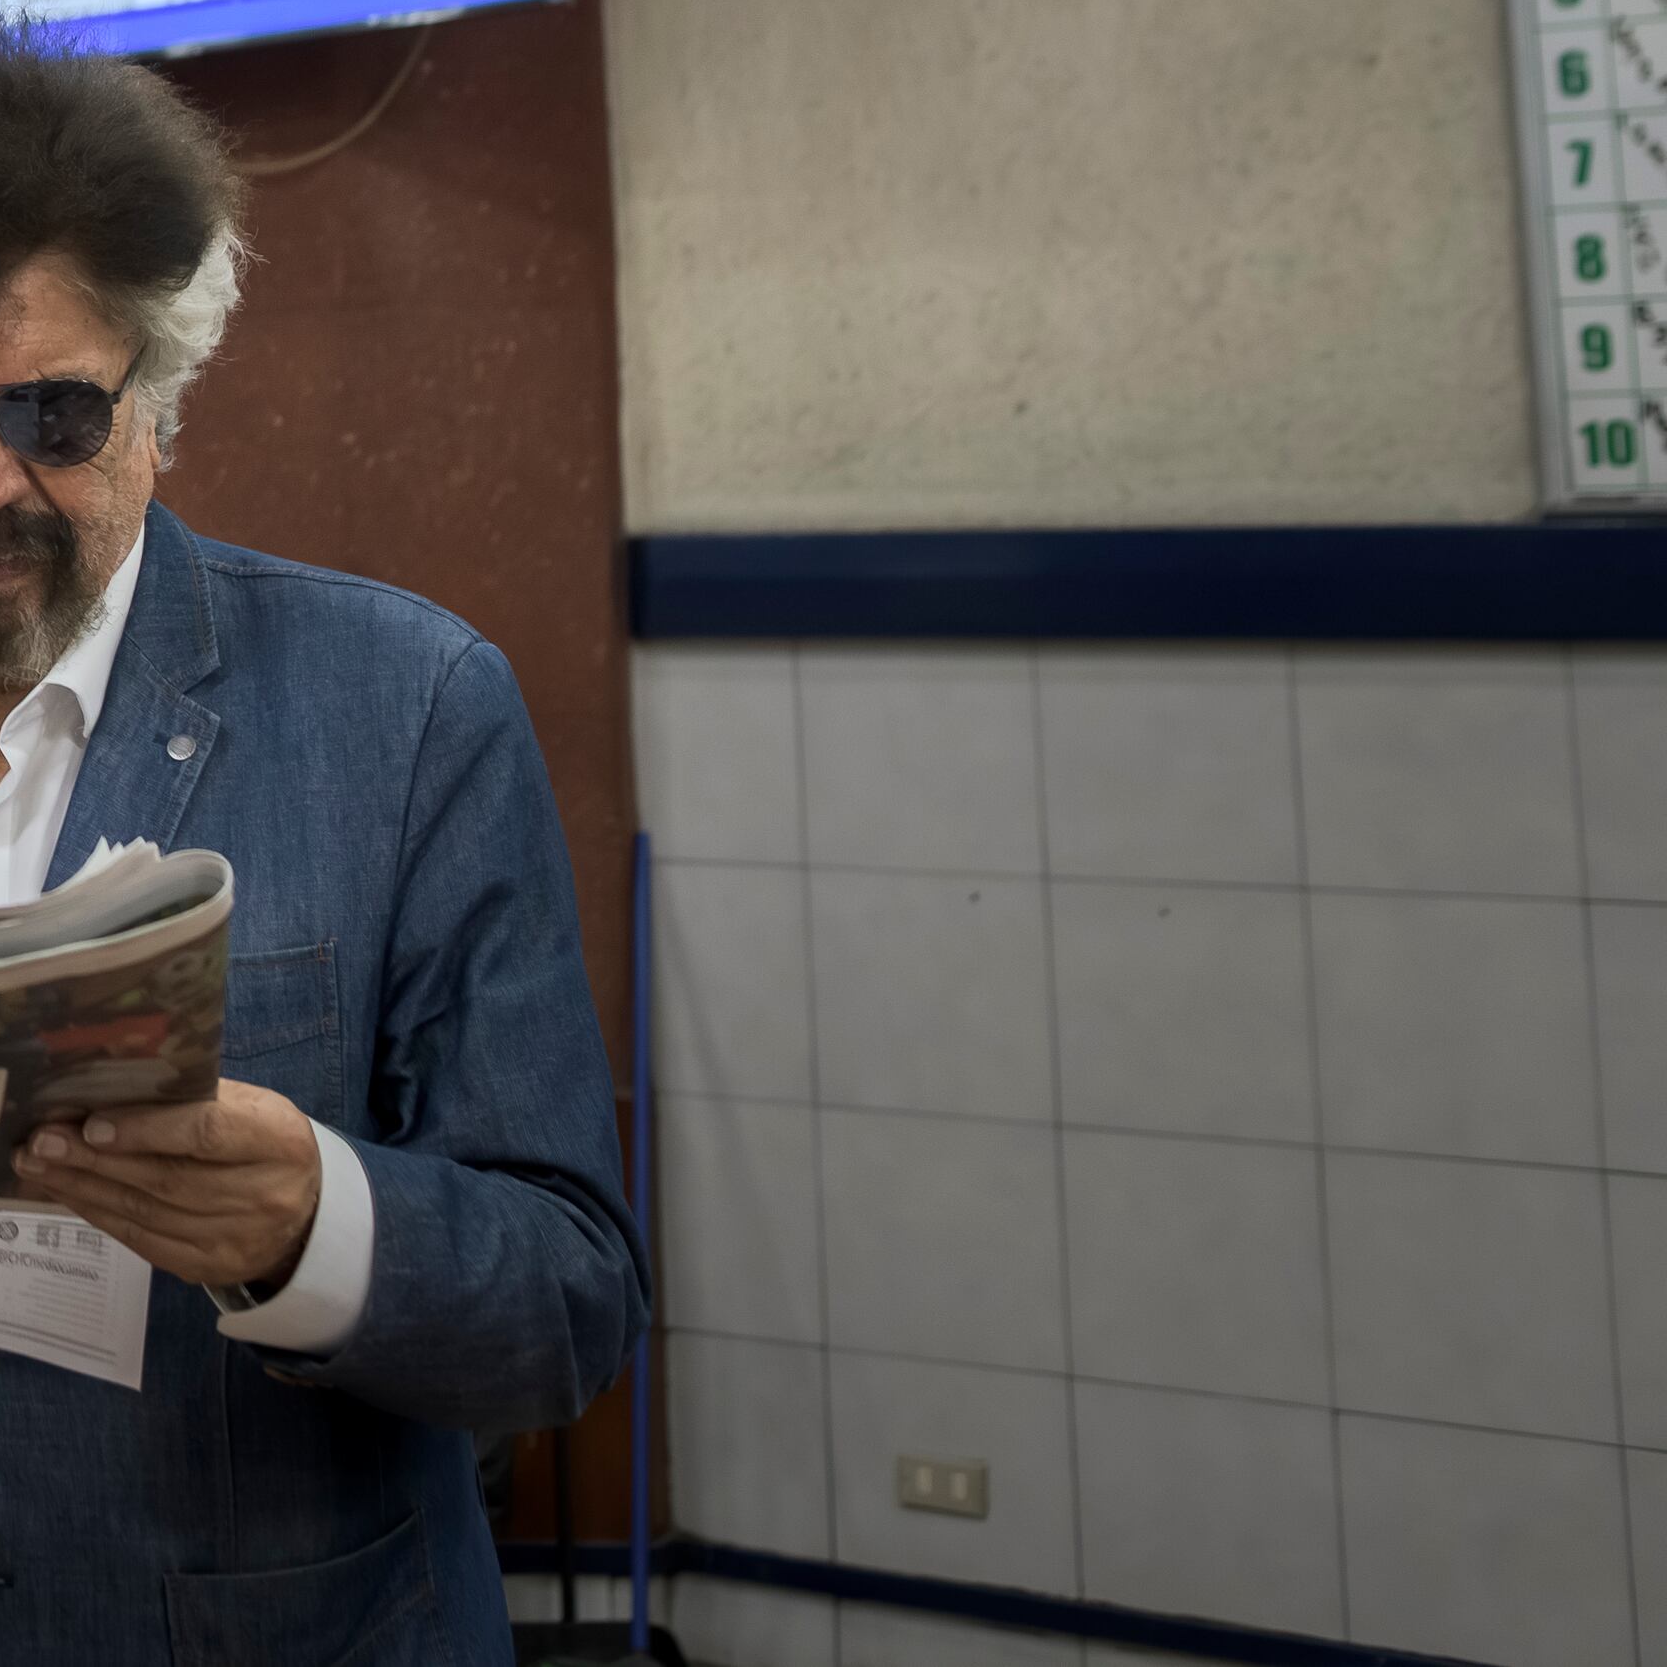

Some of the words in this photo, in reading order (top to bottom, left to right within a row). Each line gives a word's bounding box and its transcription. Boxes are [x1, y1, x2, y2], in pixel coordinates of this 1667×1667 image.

[1557, 47, 1592, 99] 6
[1566, 139, 1594, 189] 7
[1574, 233, 1607, 284] 8
[1581, 322, 1613, 372] 9
[1579, 419, 1637, 468] 10
